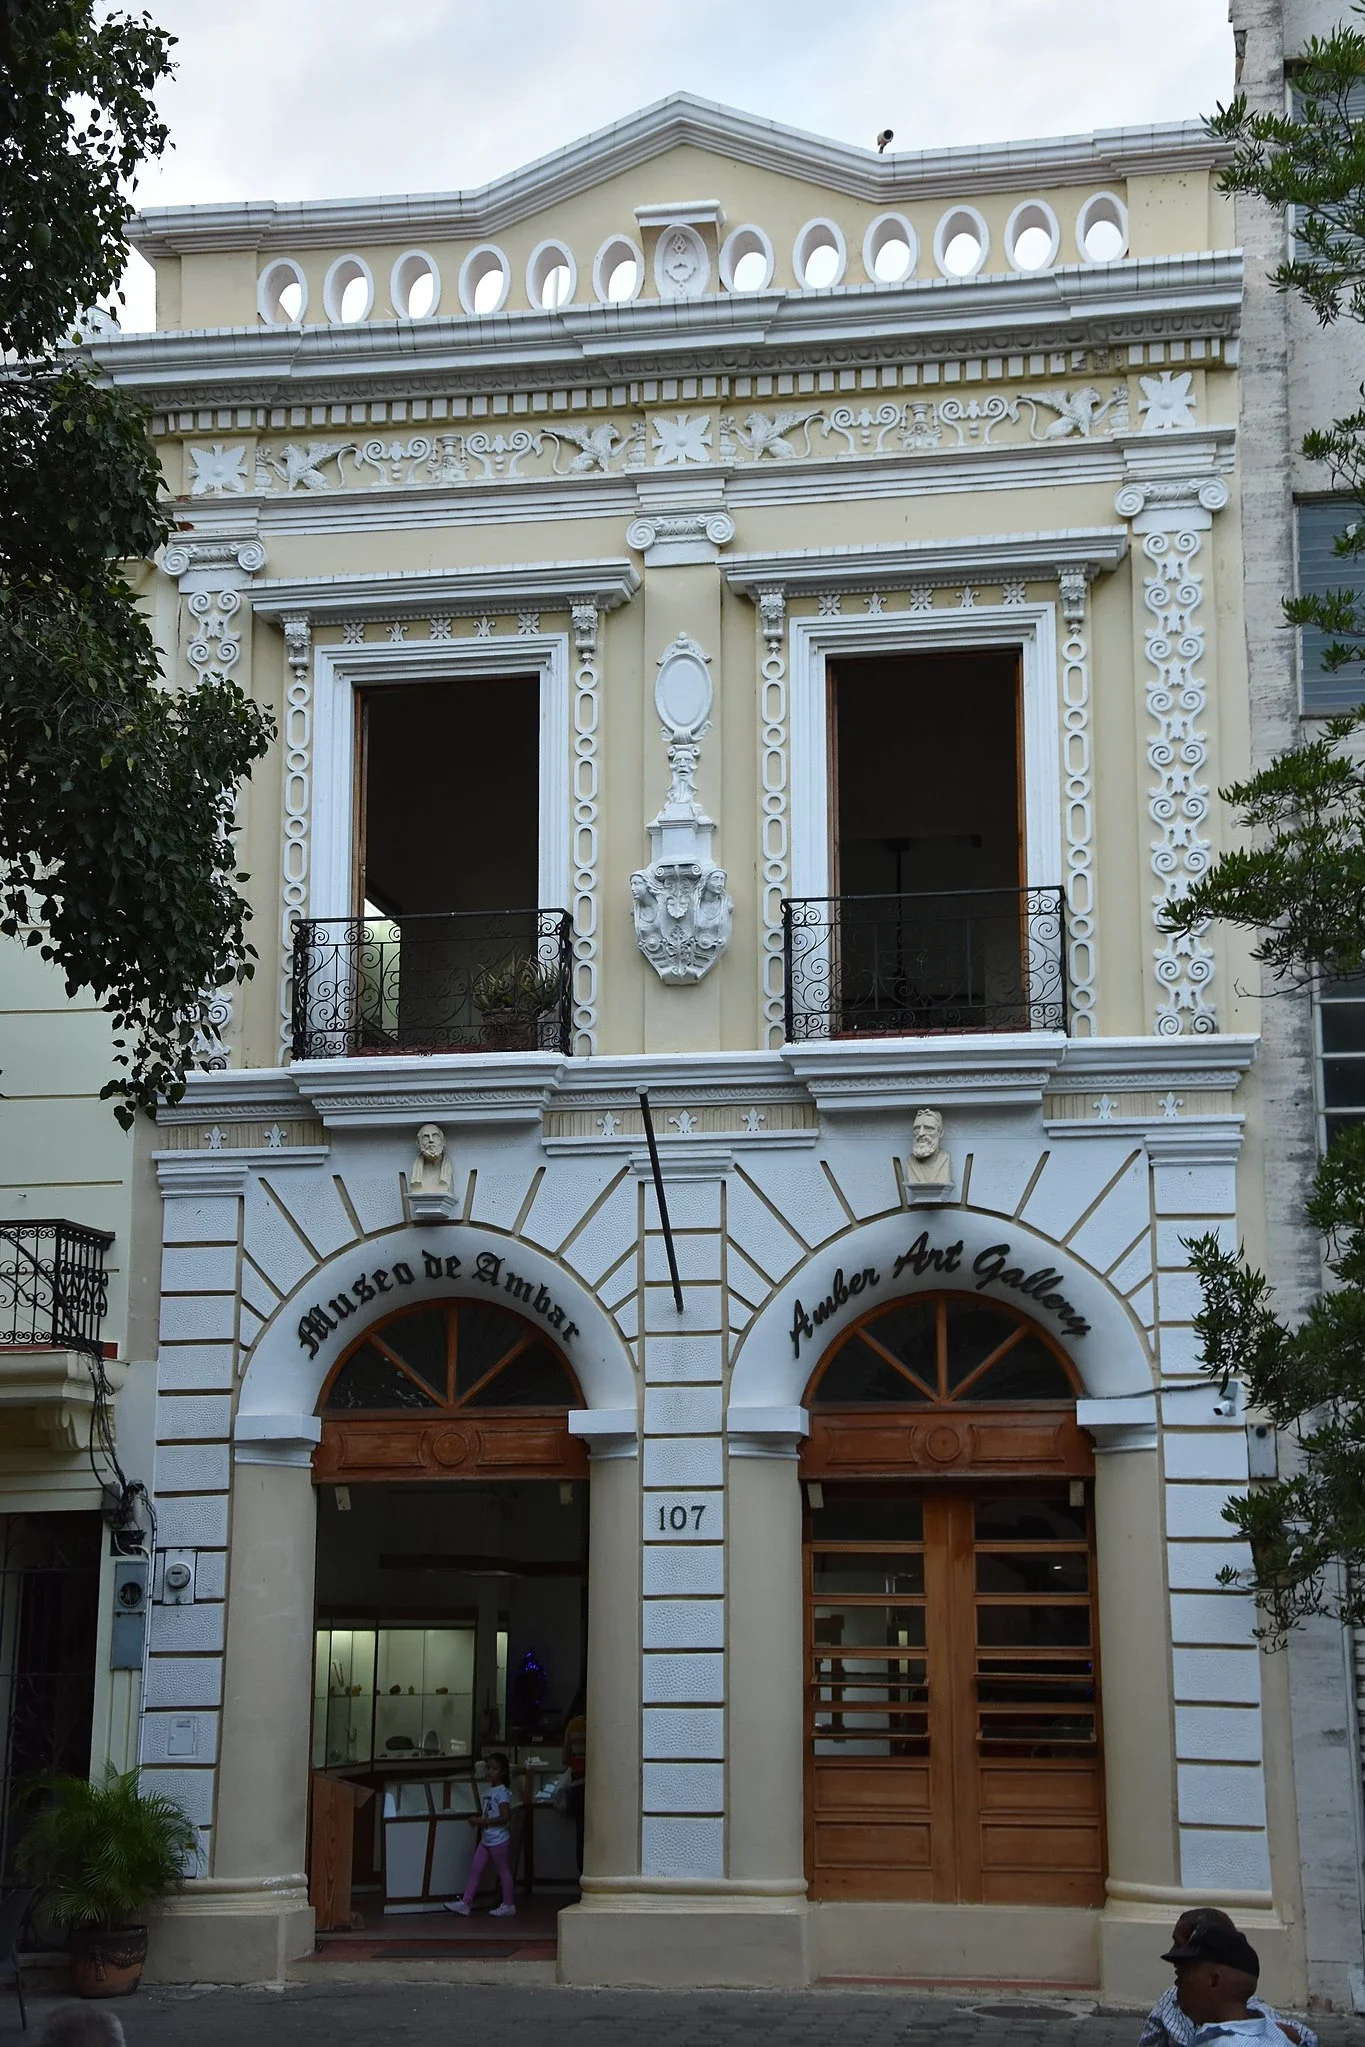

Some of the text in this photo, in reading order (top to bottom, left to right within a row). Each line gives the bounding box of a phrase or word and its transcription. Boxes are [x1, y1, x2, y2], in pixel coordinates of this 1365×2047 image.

[298, 1249, 580, 1361] Museo de Ambar
[790, 1231, 1092, 1359] Amber Art Gallery
[659, 1505, 707, 1530] 107
